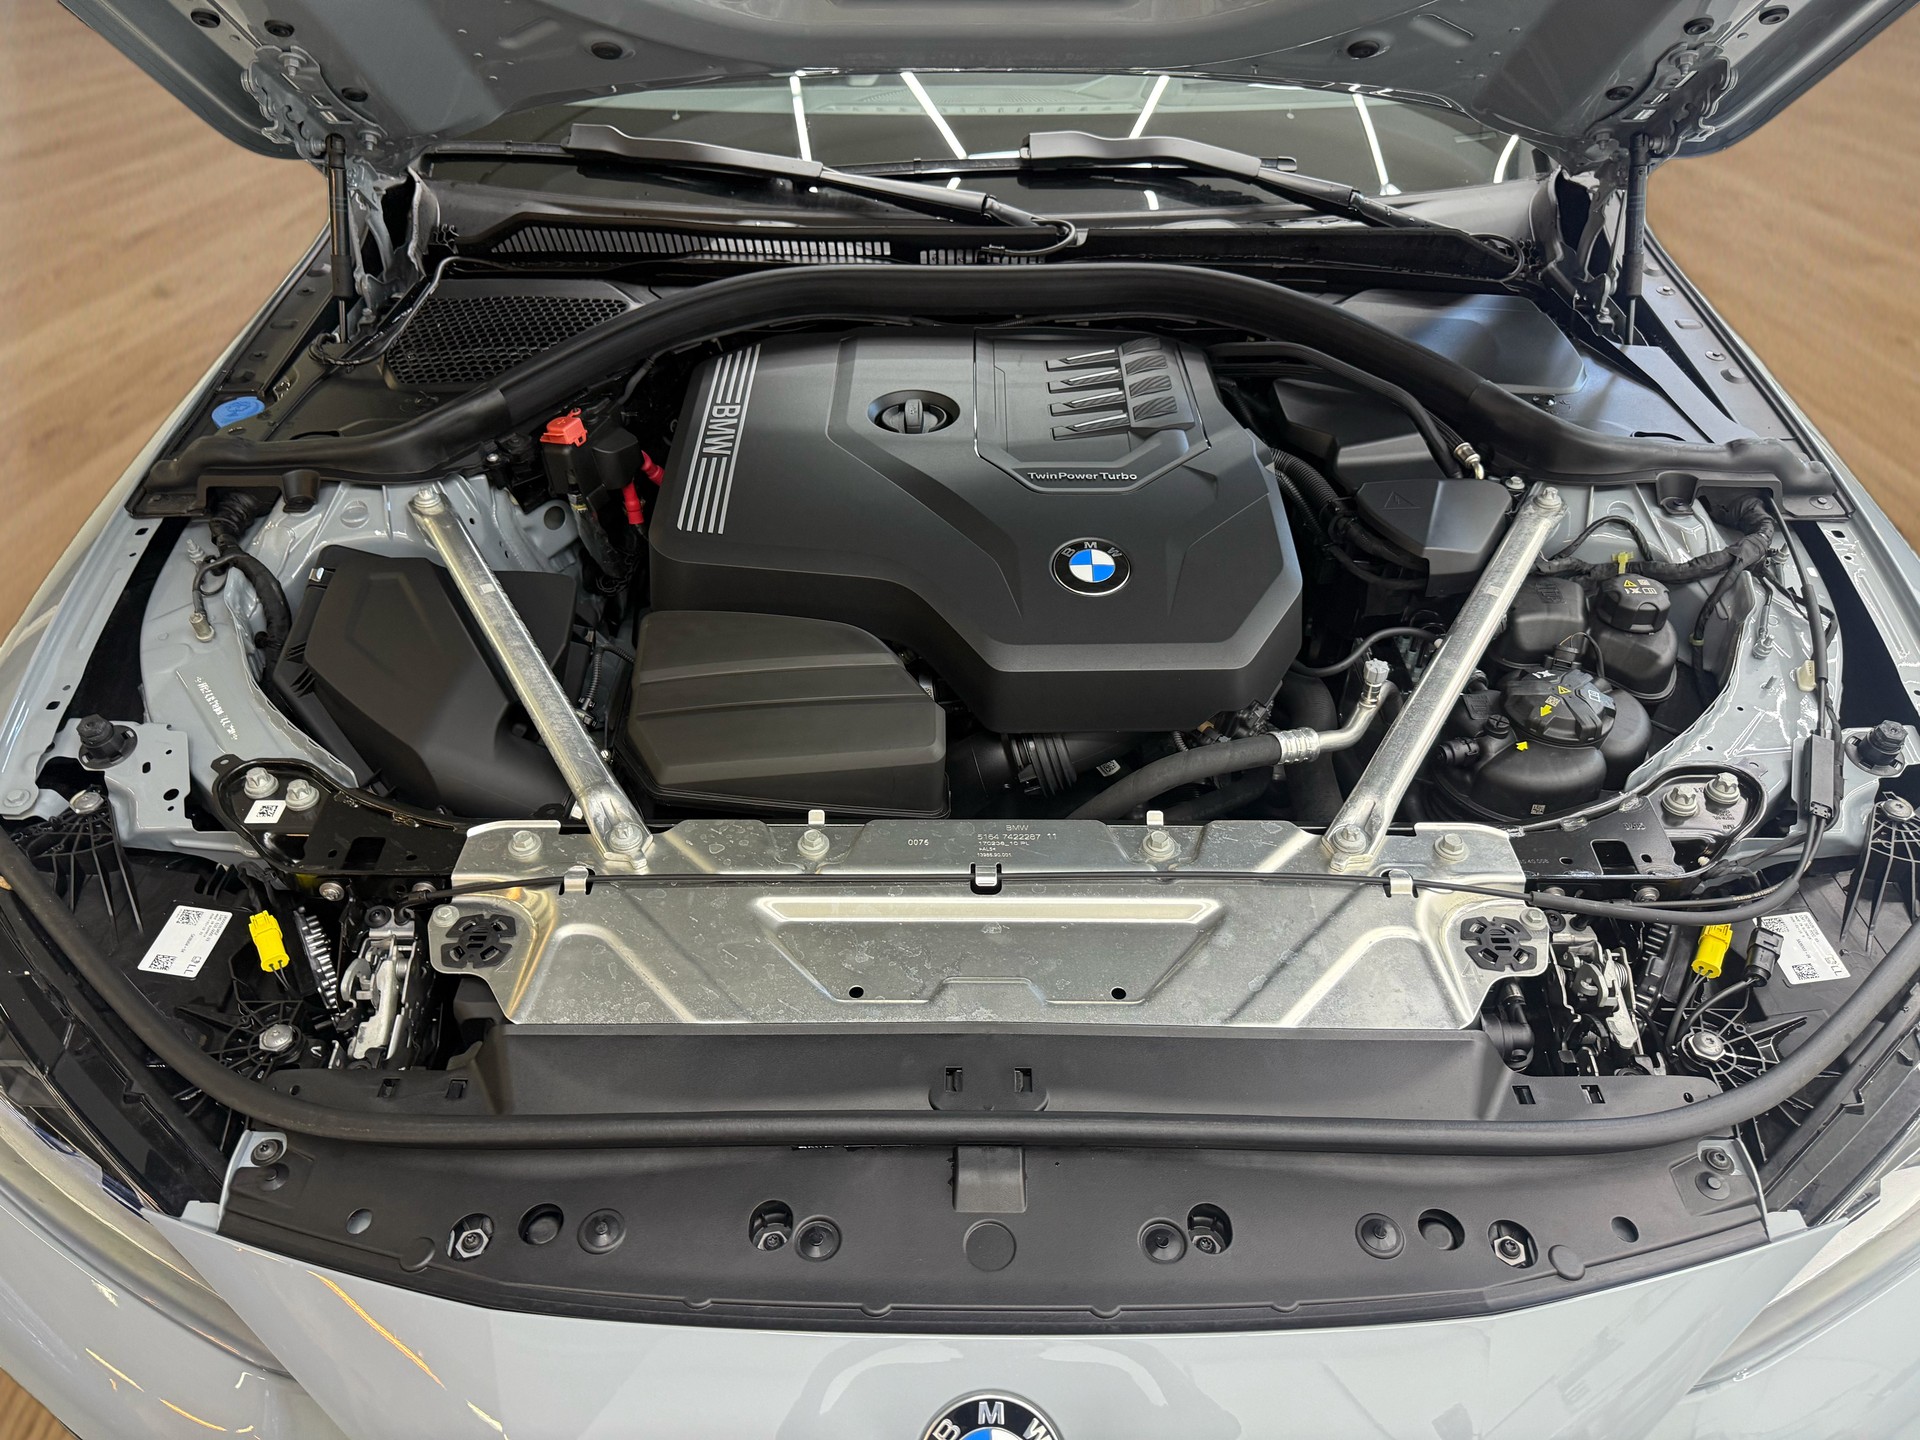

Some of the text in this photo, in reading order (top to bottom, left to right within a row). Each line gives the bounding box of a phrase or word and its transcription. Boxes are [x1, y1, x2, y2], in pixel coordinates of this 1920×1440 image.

[702, 404, 741, 456] BMW
[1099, 472, 1138, 480] Turbo
[1061, 541, 1123, 558] BMW
[1005, 824, 1029, 832] BMW
[1002, 833, 1041, 841] 7422287
[907, 838, 930, 846] 0076
[932, 1401, 1053, 1440] BMW
